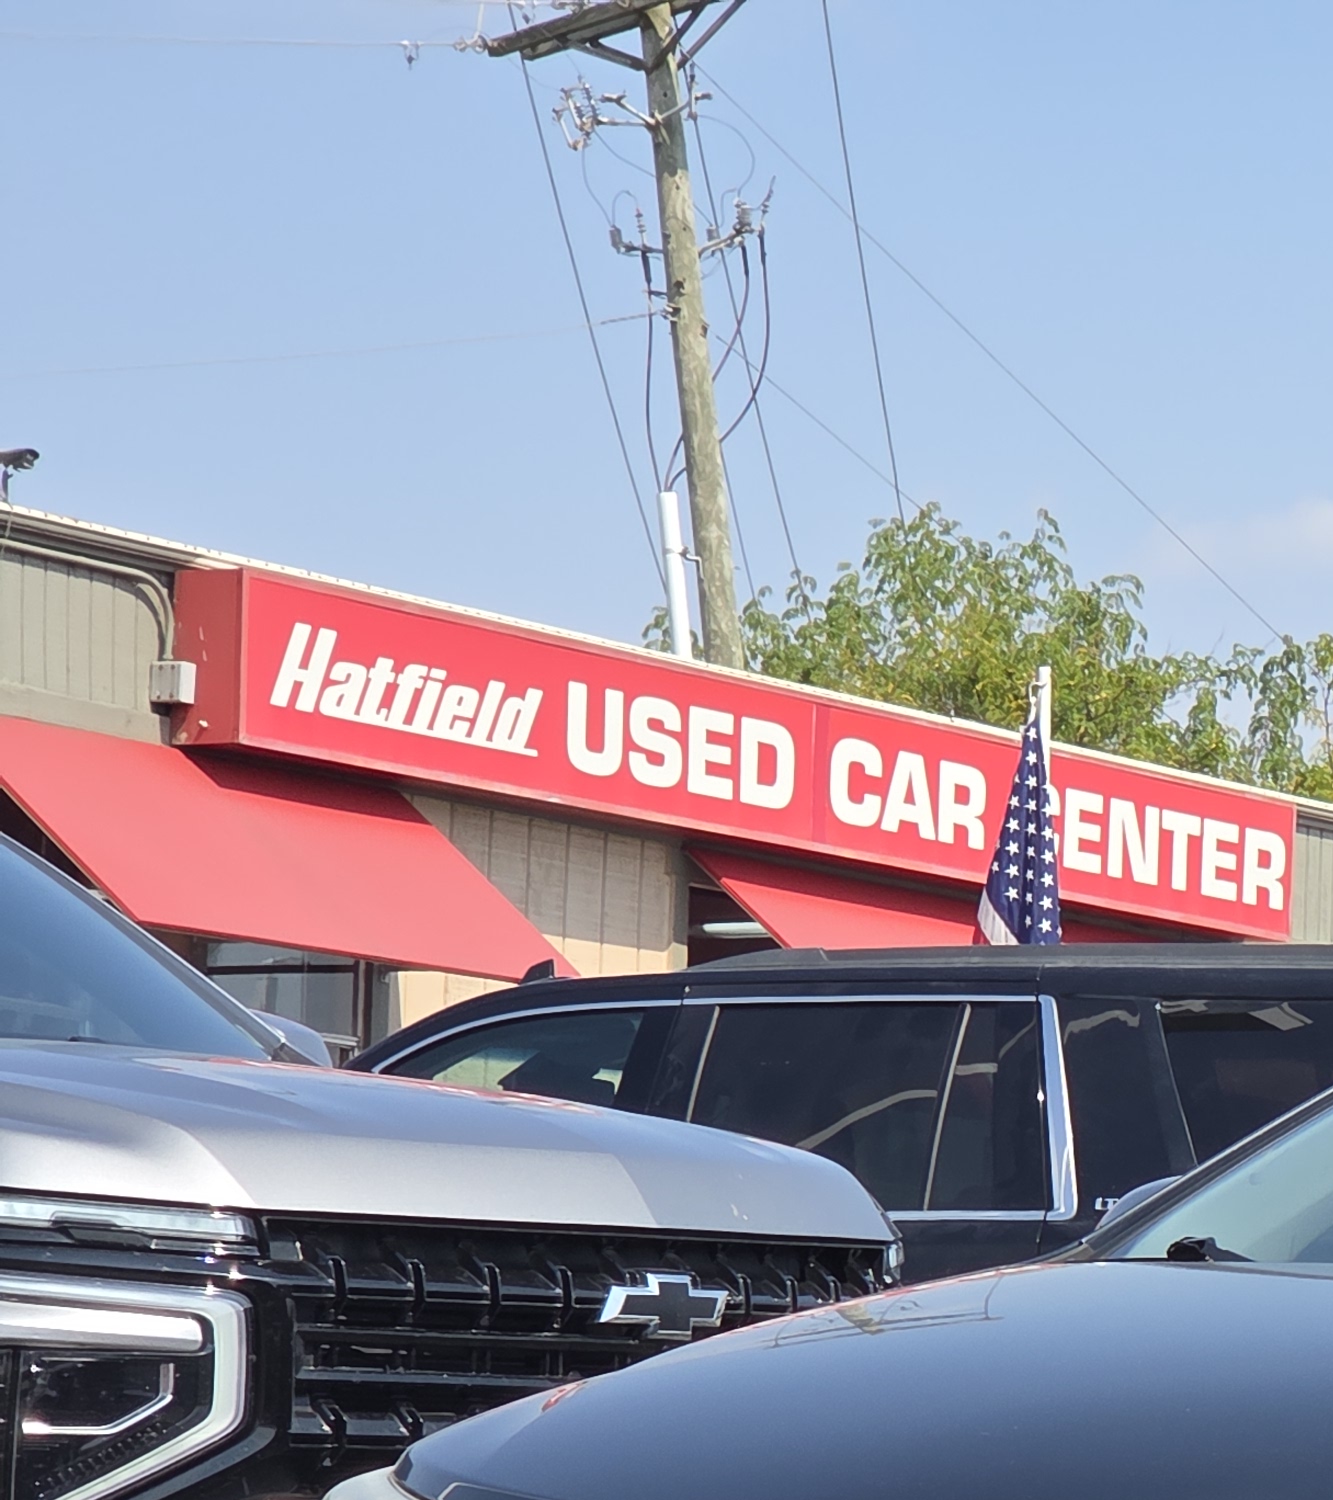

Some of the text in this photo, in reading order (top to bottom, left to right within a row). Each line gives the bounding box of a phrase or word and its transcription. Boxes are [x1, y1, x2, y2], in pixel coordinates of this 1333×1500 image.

[270, 622, 1286, 911] Hatfield USED CAR ENTER
